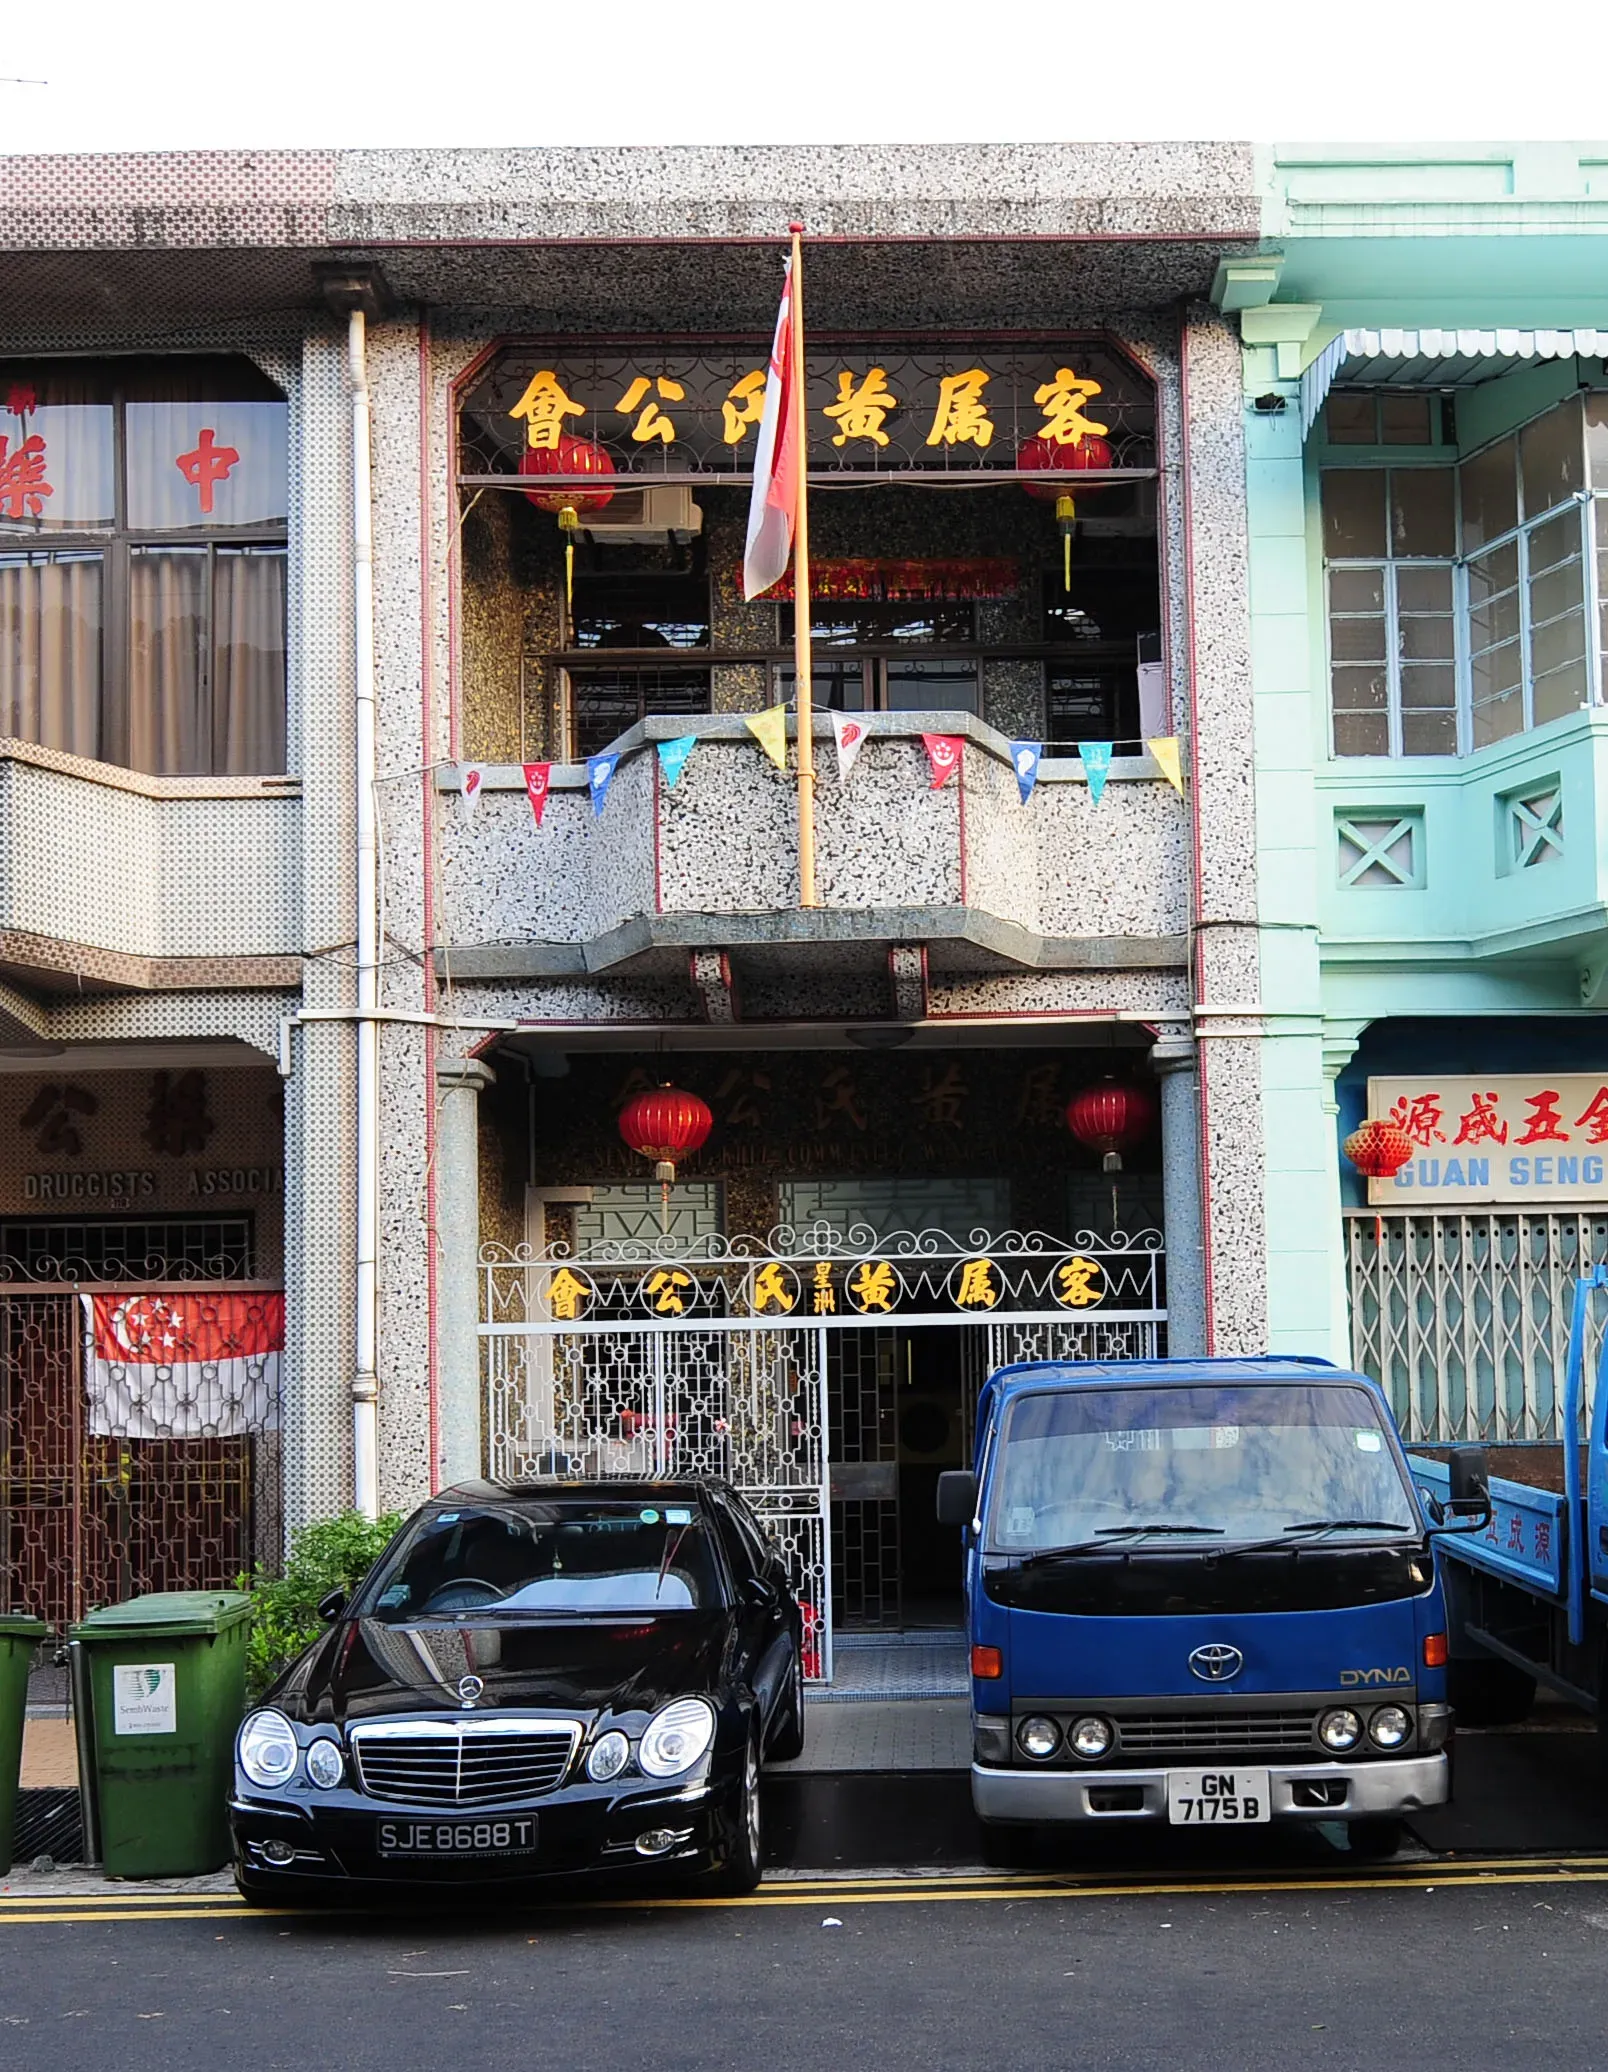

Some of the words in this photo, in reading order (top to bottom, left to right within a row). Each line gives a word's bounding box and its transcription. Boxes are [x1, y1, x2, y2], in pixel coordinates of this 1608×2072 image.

[1394, 1158, 1489, 1188] GUAN
[1509, 1155, 1604, 1185] SENG
[24, 1171, 155, 1199] DRUGGISTS
[1340, 1667, 1411, 1685] DYNA
[120, 1704, 168, 1714] SembWaste
[1201, 1774, 1235, 1796] GN
[381, 1821, 532, 1849] SJE8688T
